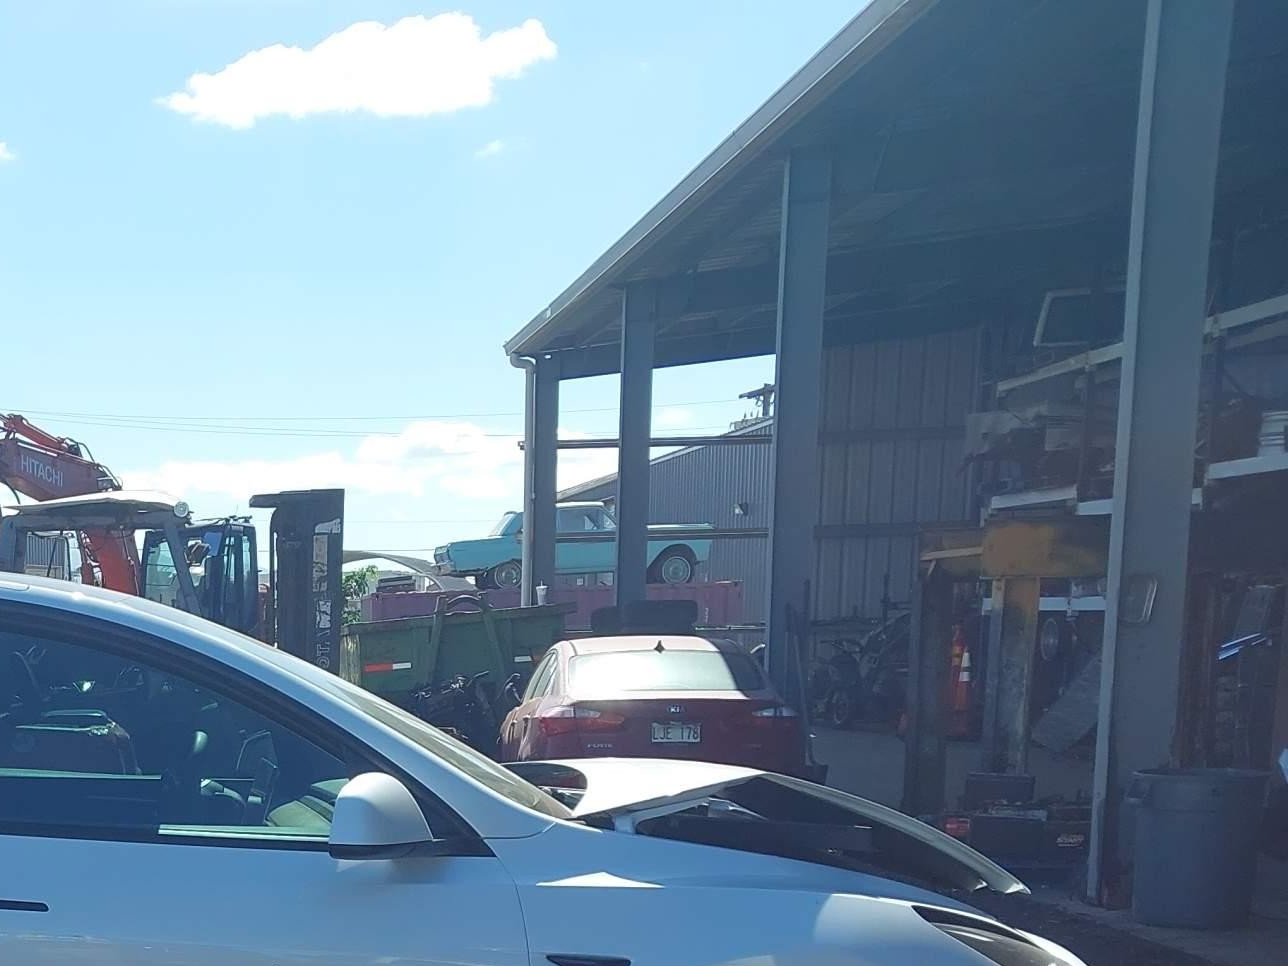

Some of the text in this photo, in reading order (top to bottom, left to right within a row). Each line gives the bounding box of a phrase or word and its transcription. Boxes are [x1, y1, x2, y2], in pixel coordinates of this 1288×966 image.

[21, 455, 64, 488] HITACHI
[653, 727, 698, 740] LJE 178
